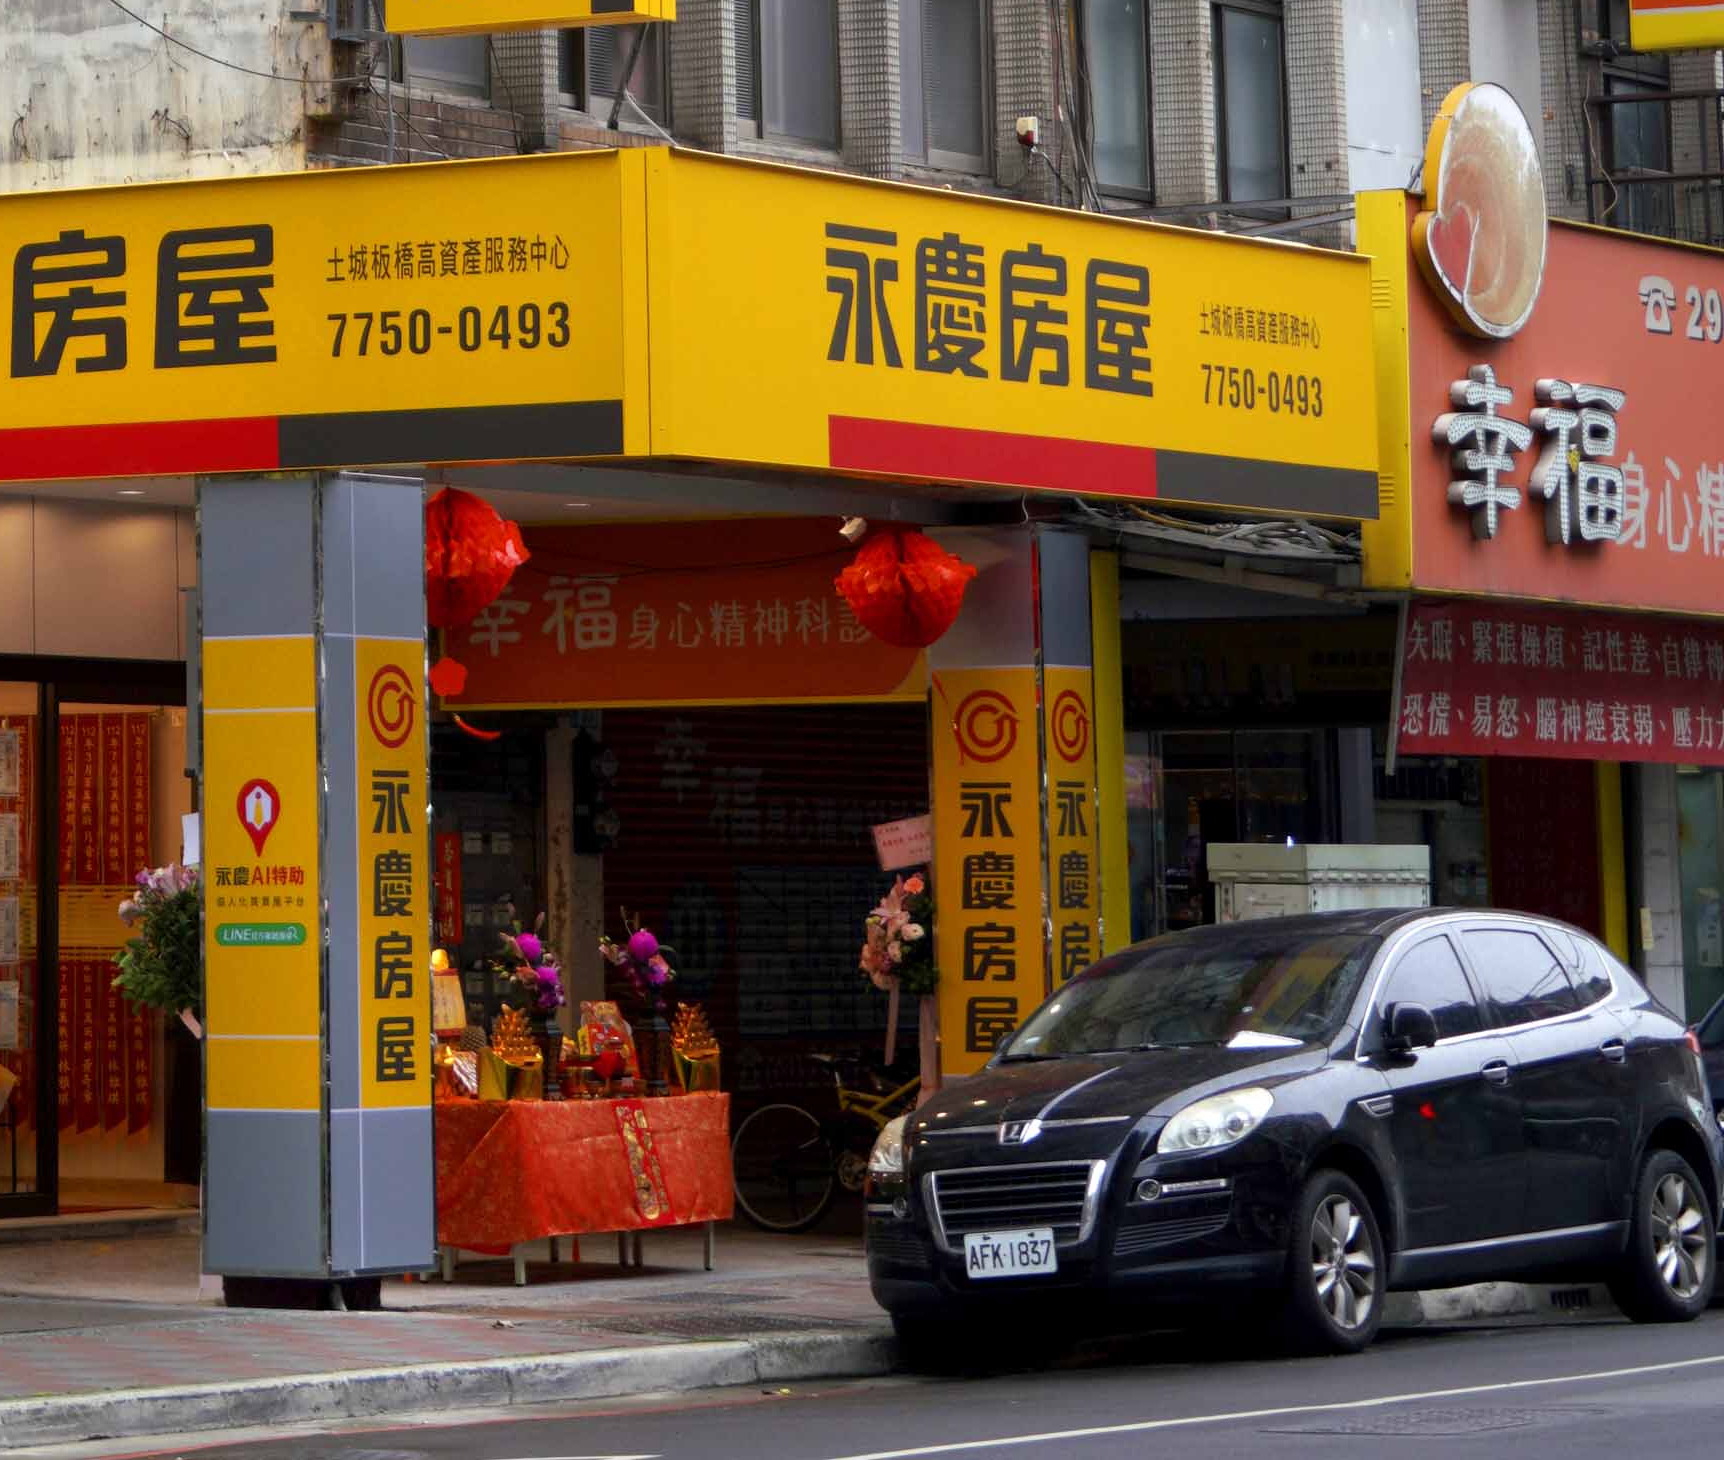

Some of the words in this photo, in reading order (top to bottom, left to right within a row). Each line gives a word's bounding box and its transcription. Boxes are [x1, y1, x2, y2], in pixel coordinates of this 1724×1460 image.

[326, 233, 571, 283] 土城板橋高資產服務中心
[326, 300, 572, 358] 7750-0493
[825, 222, 1154, 398] 永慶房屋
[1201, 363, 1324, 418] 7750-0493
[1431, 363, 1627, 546] 幸福
[371, 768, 417, 1084] 永慶房屋
[960, 781, 1019, 1053] 永慶房屋
